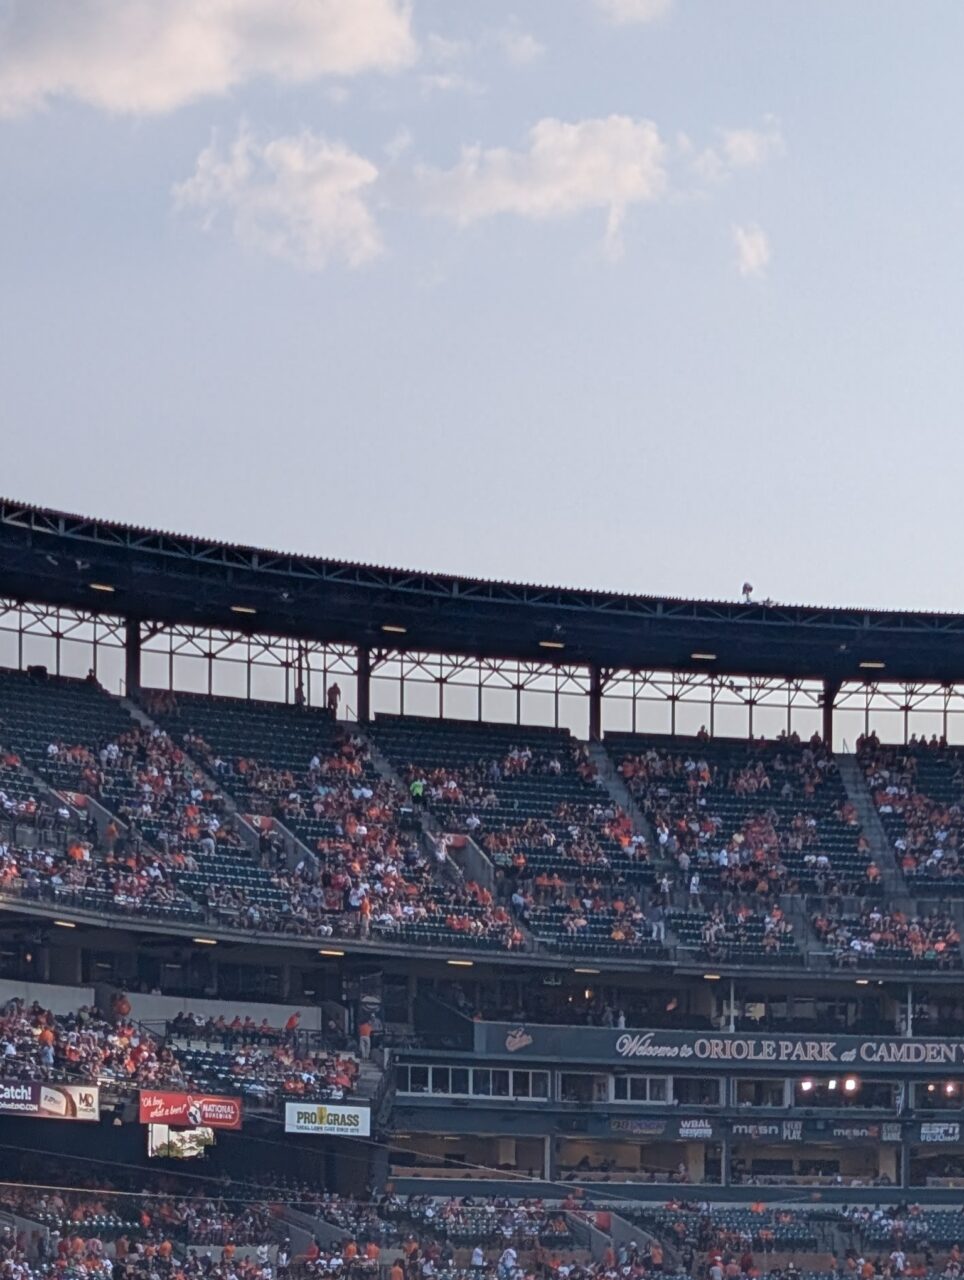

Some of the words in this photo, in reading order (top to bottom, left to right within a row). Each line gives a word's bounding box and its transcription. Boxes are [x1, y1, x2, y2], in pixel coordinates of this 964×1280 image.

[616, 1032, 679, 1057] Welcome
[679, 1044, 693, 1058] to
[694, 1038, 776, 1061] ORIOLE
[778, 1040, 837, 1061] PARK
[860, 1042, 957, 1063] CAMDEN
[202, 1103, 235, 1114] NATIONAL
[296, 1111, 317, 1124] PRO
[326, 1113, 360, 1127] GRASS
